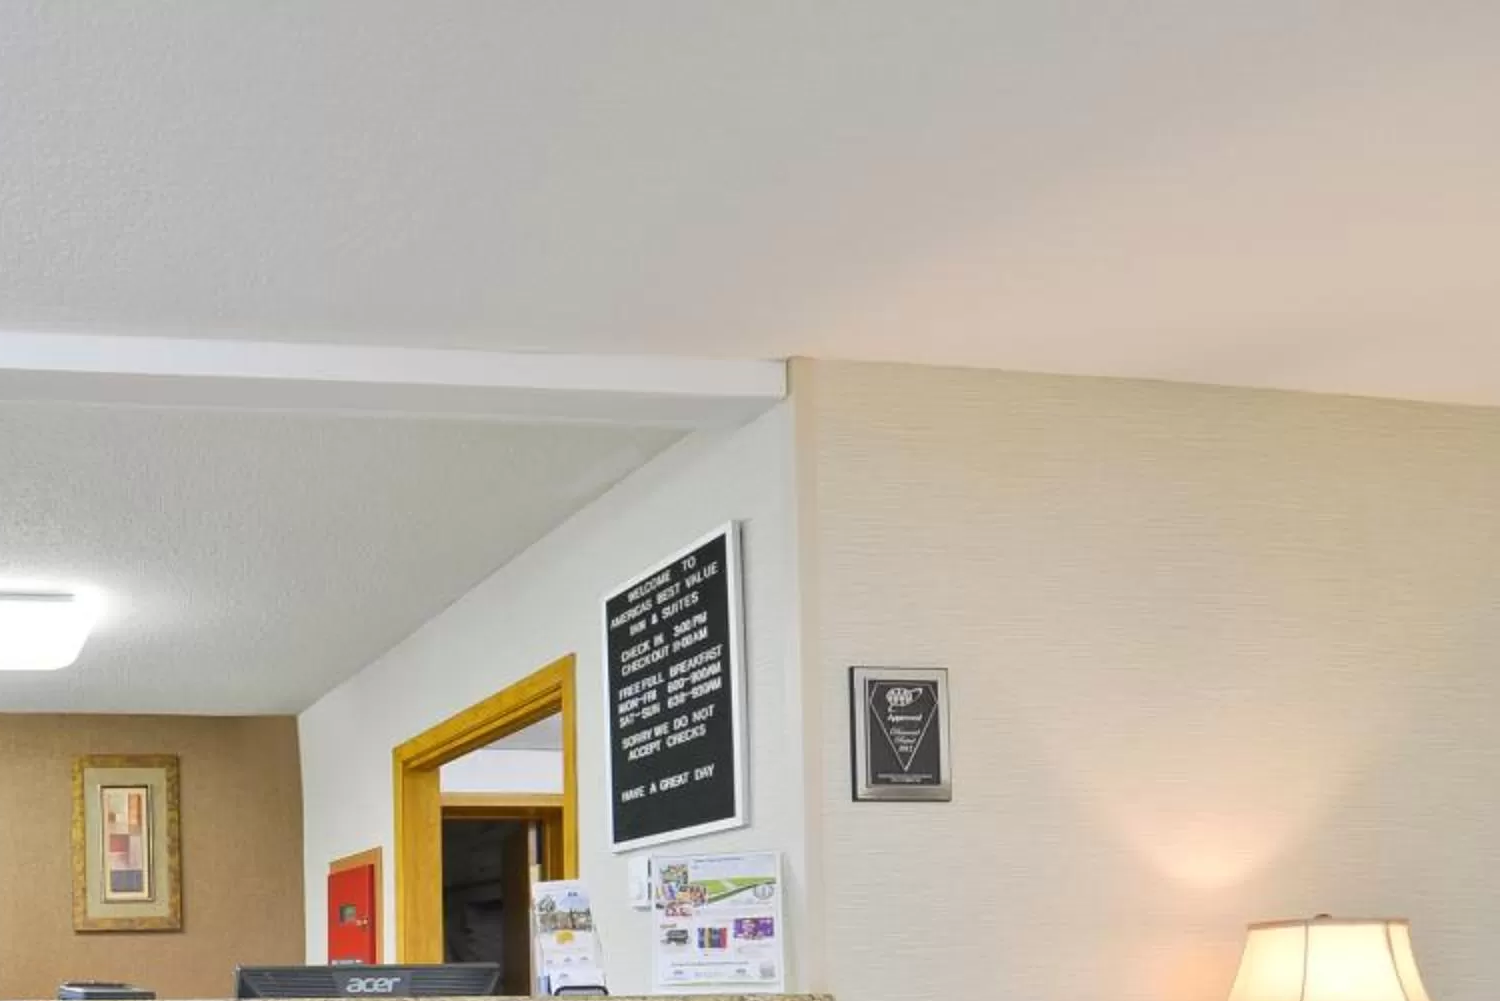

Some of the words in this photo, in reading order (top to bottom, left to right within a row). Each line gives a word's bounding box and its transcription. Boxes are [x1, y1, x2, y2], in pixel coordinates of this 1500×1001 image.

[610, 599, 652, 628] AMERICAS
[656, 584, 680, 605] BEST
[684, 562, 719, 589] VALUE
[627, 570, 672, 601] WELCOME
[681, 556, 697, 570] TO
[661, 592, 699, 620] SUITES
[621, 640, 651, 663] CHECK
[621, 655, 651, 676] CHECK
[651, 645, 670, 663] OUT
[618, 680, 642, 700] FREE
[641, 672, 665, 691] FULL
[669, 644, 724, 678] BREAKFAST
[621, 729, 653, 750] SORRY
[654, 722, 670, 738] WE
[673, 715, 689, 730] DO
[692, 704, 715, 722] NOT
[627, 740, 662, 761] ACCEPT
[666, 724, 707, 748] CHECKS
[621, 785, 646, 803] HAVE
[649, 782, 658, 795] A
[659, 771, 691, 792] GREAT
[694, 763, 715, 781] DAY
[346, 976, 401, 993] acer
